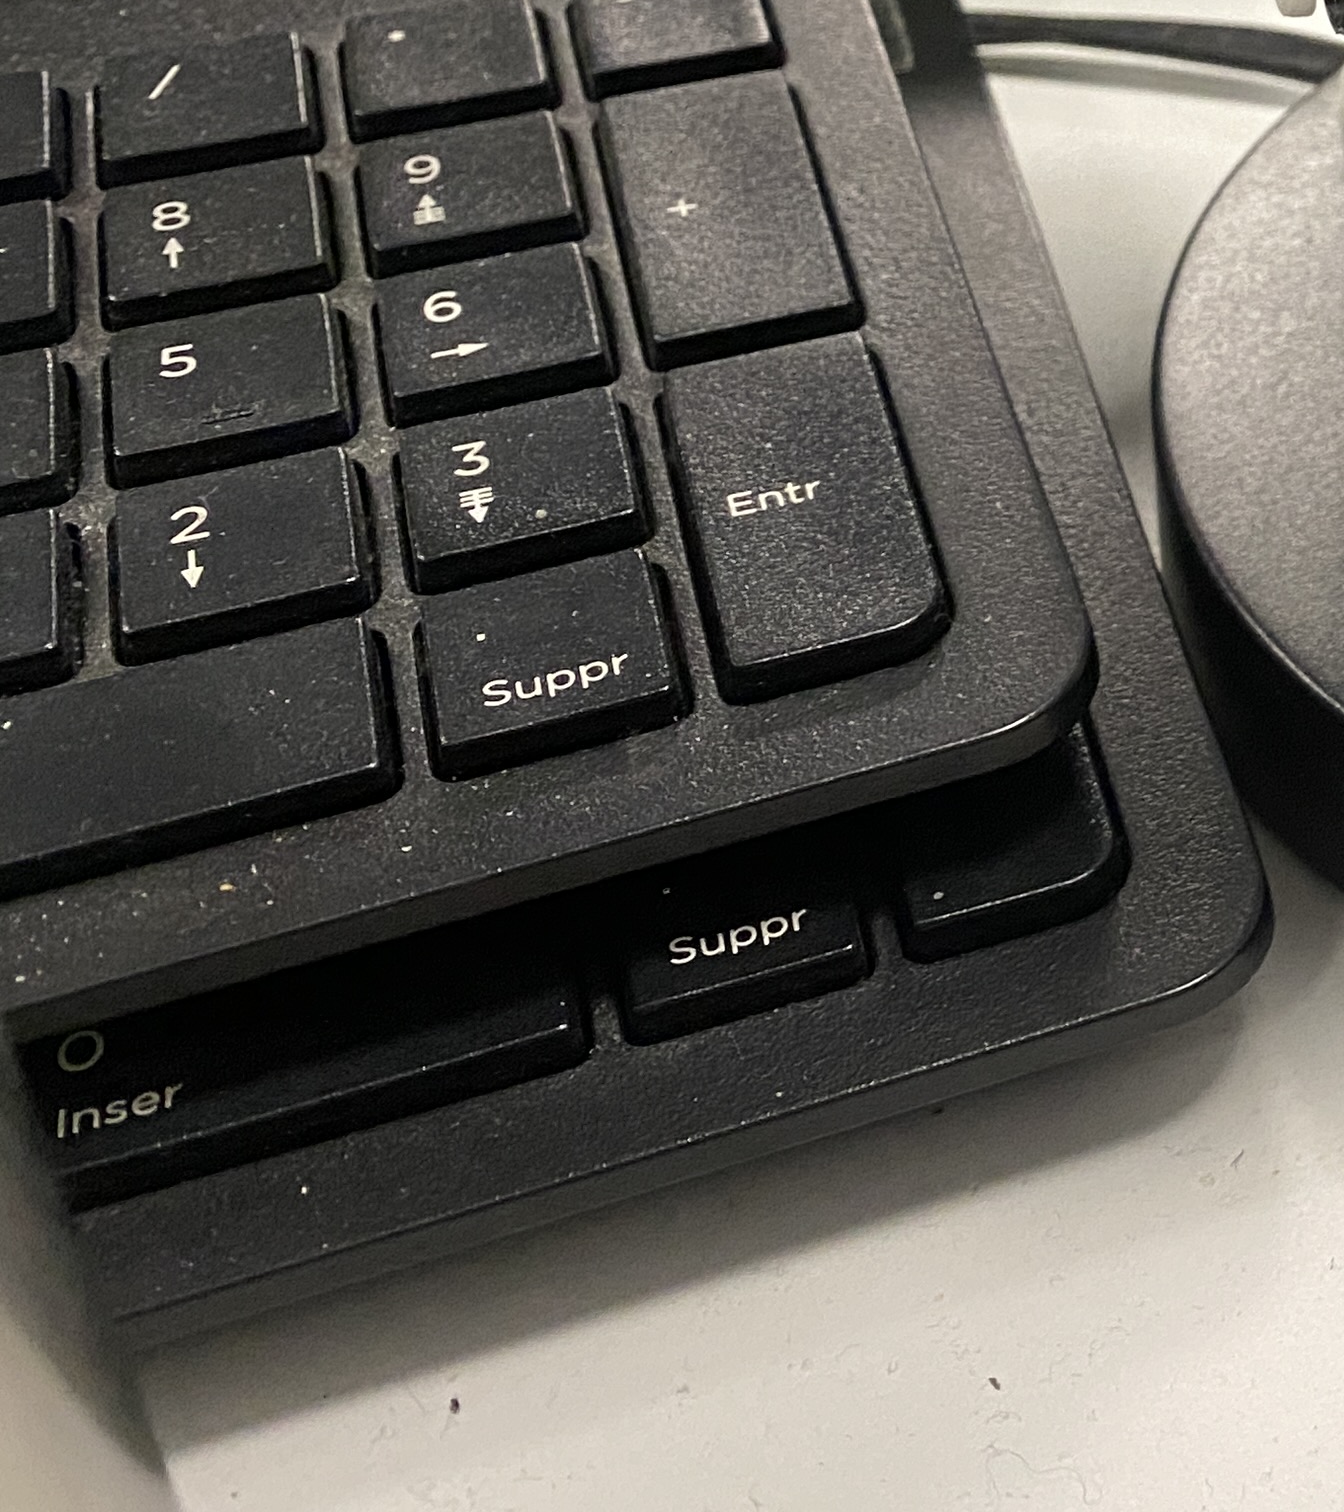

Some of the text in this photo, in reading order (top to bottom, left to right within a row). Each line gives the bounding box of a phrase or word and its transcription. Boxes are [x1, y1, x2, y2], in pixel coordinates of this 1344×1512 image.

[403, 154, 441, 185] 9
[151, 201, 191, 231] 8
[423, 290, 463, 323] 6
[158, 343, 197, 378] 5
[451, 440, 490, 477] 3
[725, 477, 822, 519] Entr
[169, 505, 211, 545] 2
[481, 651, 630, 708] Suppr
[669, 907, 808, 966] Suppr
[56, 1082, 184, 1139] Inser
